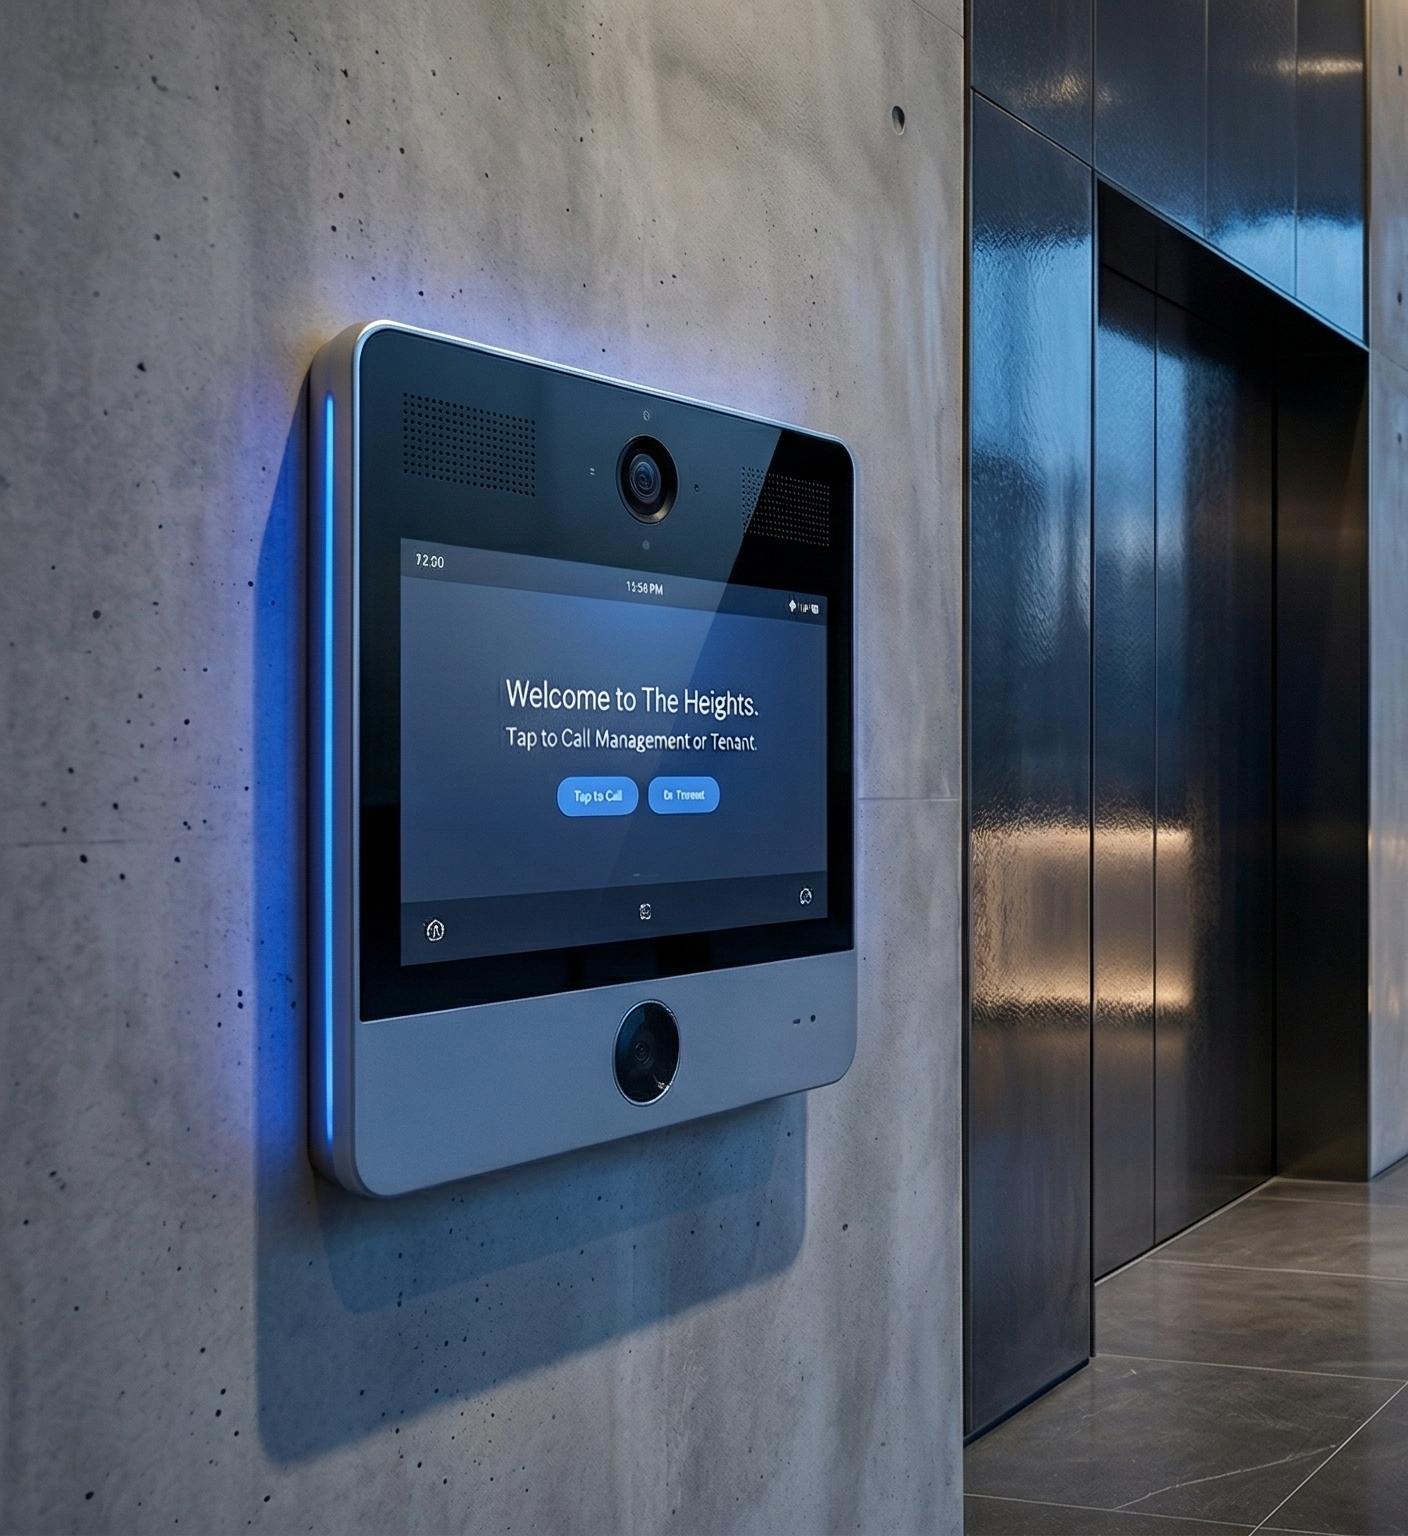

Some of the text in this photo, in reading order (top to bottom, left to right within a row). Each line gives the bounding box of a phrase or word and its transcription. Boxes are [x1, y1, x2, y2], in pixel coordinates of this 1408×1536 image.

[649, 582, 664, 596] PM
[506, 679, 759, 721] Welcome to The Heights.
[506, 727, 758, 753] Tap to Call Management or Tenant.
